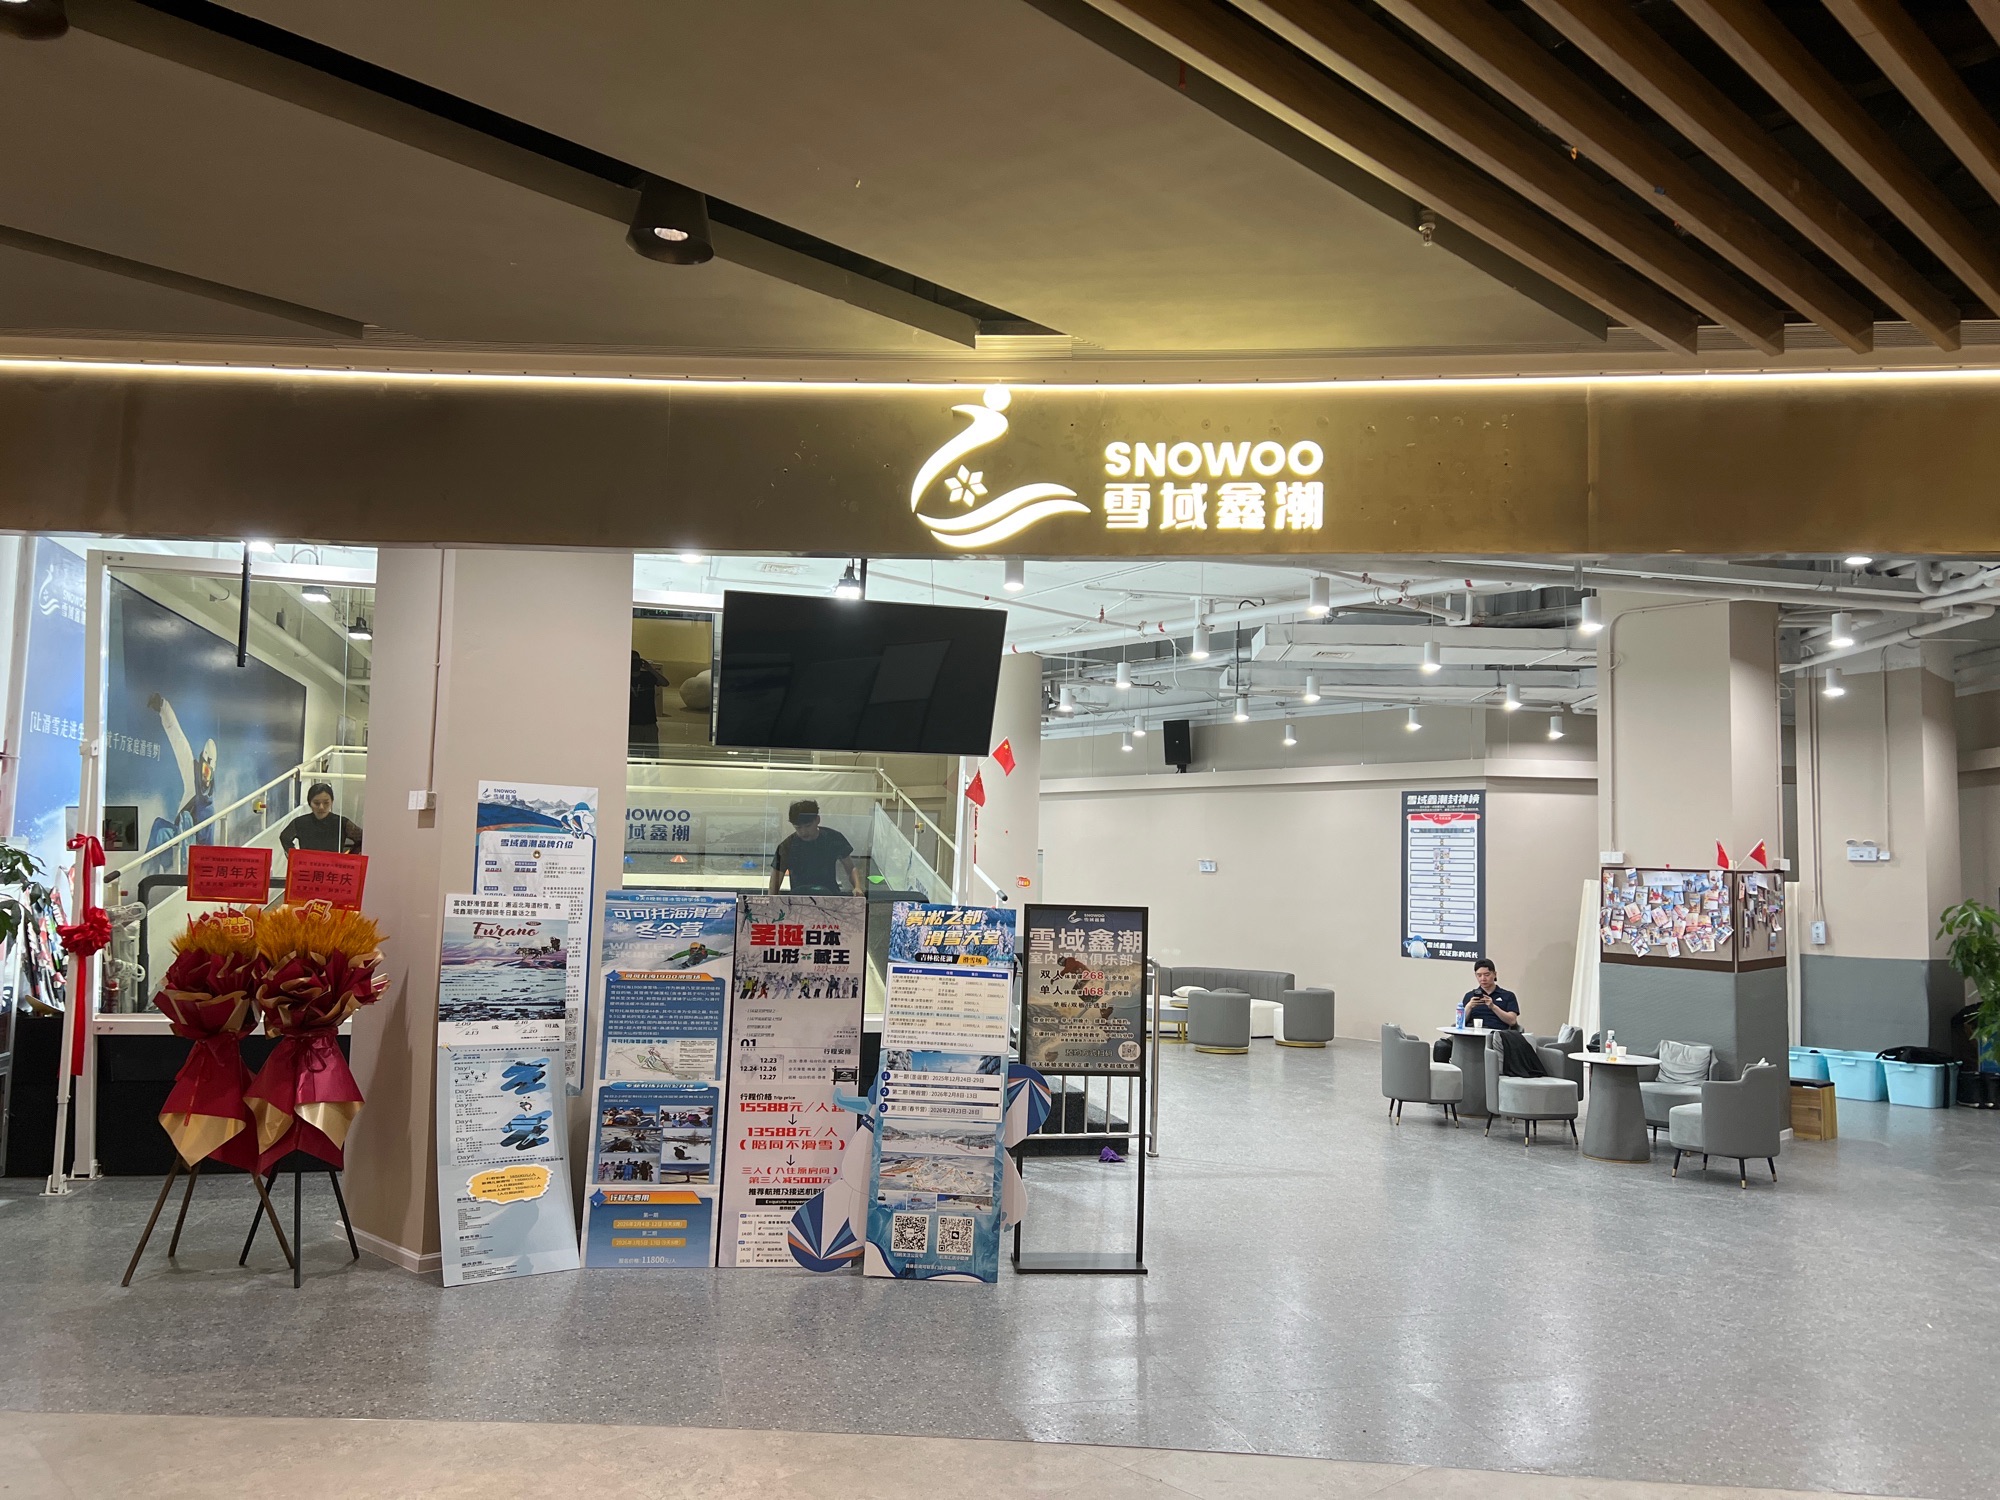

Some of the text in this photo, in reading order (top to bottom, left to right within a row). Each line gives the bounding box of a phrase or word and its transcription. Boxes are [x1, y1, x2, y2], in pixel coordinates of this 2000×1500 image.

[1104, 441, 1323, 476] SNOWOO
[1104, 482, 1324, 530] 雪域鑫潮
[500, 839, 573, 849] 雪域鑫潮品牌介绍
[200, 866, 258, 880] 三周年庆
[298, 870, 353, 886] 三周年庆
[611, 907, 727, 919] 可可托海滑雪
[905, 910, 982, 926] 雾凇之都
[473, 922, 539, 940] Furano
[635, 922, 704, 939] 冬令营
[924, 929, 1001, 946] 滑雪天堂
[1029, 928, 1142, 953] 雪域鑫潮
[763, 948, 850, 964] 山形 藏王
